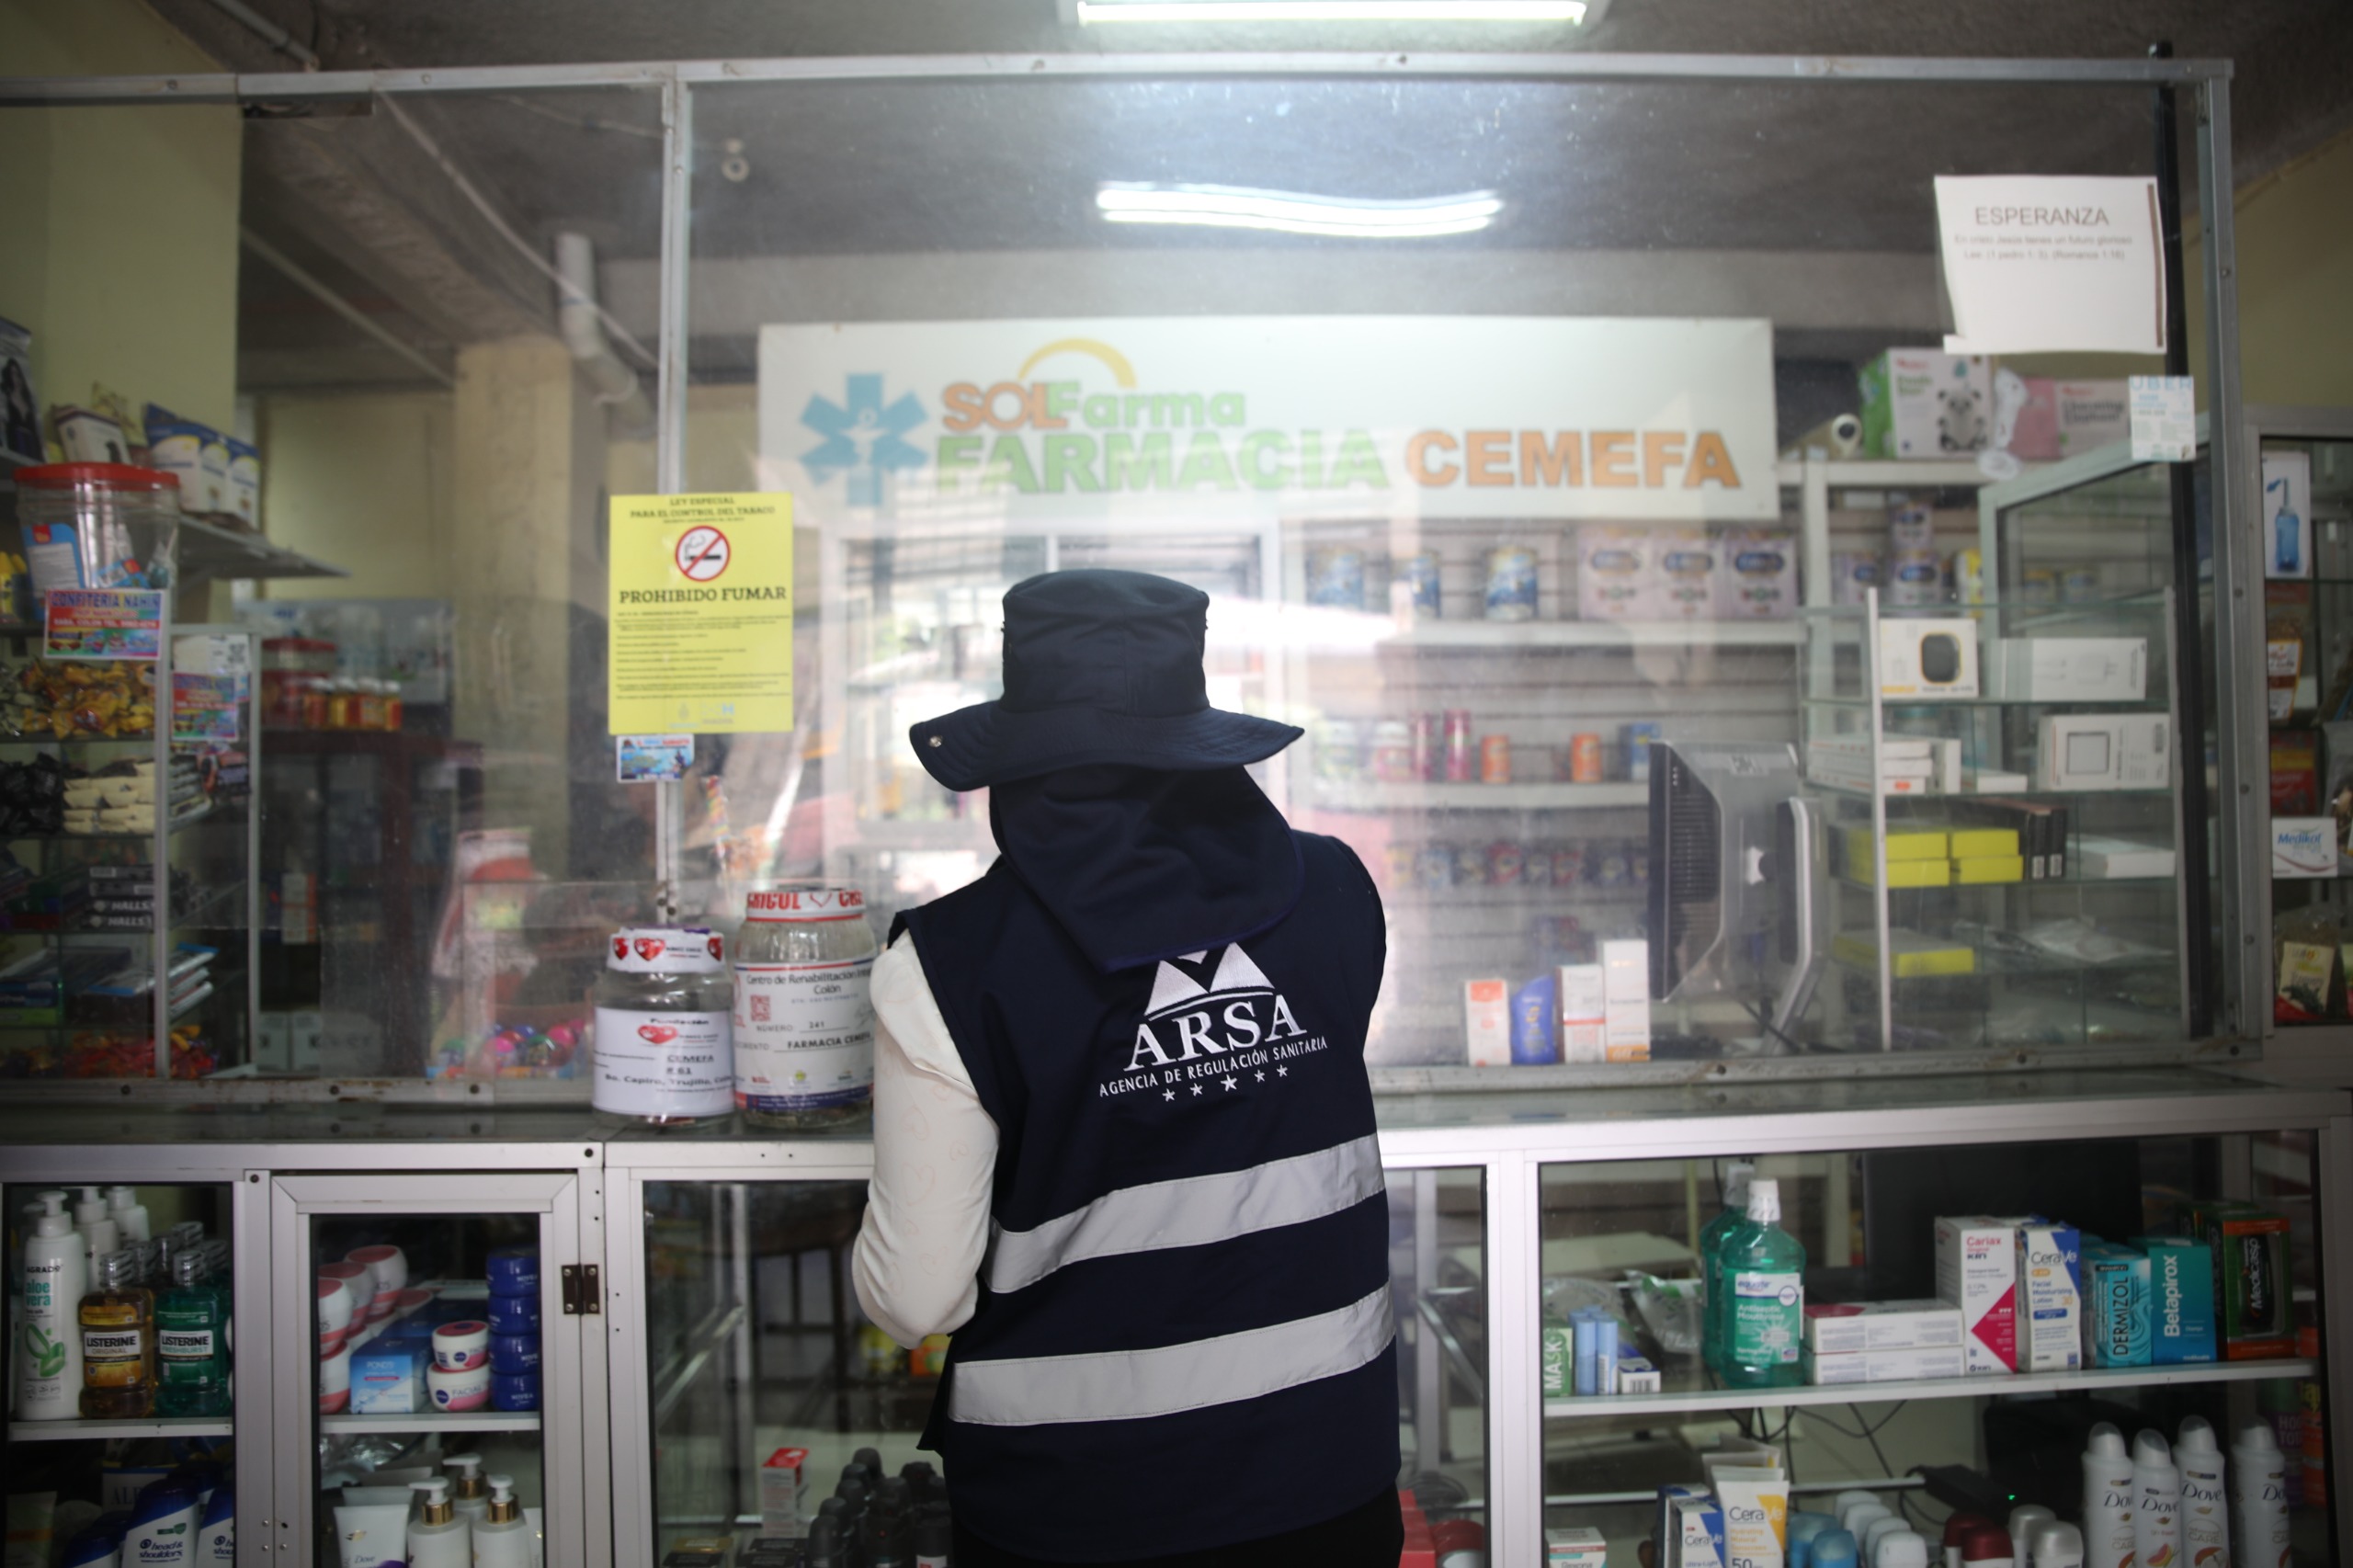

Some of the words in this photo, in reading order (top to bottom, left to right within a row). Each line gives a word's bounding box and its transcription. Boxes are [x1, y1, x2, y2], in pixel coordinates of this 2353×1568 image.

[1975, 206, 2110, 226] ESPERANZA
[936, 428, 1392, 494] FARMACIA
[1404, 428, 1744, 492] CEMEFA
[689, 496, 735, 506] ESPECIAL
[630, 510, 655, 518] PARA
[670, 508, 715, 517] CONTROL
[737, 506, 776, 515] TABACO
[619, 588, 718, 605] PROHIBIDO
[722, 586, 788, 602] FUMAR
[111, 900, 150, 911] HALLS
[747, 974, 773, 984] Centro
[774, 974, 786, 983] de
[813, 984, 842, 995] Colón
[1123, 994, 1308, 1072] ARSA
[787, 1036, 842, 1050] FARMACIA
[1099, 1072, 1159, 1097] AGENCIA
[1164, 1068, 1182, 1084] DE
[1187, 1048, 1269, 1080] REGULACIÓN
[1272, 1035, 1328, 1062] SANITARIA
[1966, 1235, 2002, 1247] Cariax
[2030, 1250, 2078, 1266] CeraVe
[2248, 1237, 2264, 1310] Medicasp
[26, 1278, 51, 1294] aloe
[26, 1294, 51, 1307] vera
[2163, 1254, 2183, 1337] Betapirox
[2112, 1276, 2130, 1357] DERMIZOL
[86, 1335, 137, 1347] LISTERINE
[161, 1335, 210, 1346] LISTERINE
[2181, 1479, 2222, 1502] Dove
[1729, 1505, 1783, 1522] CeraVe
[1684, 1534, 1723, 1547] CeraVe
[139, 1550, 184, 1559] shoulders
